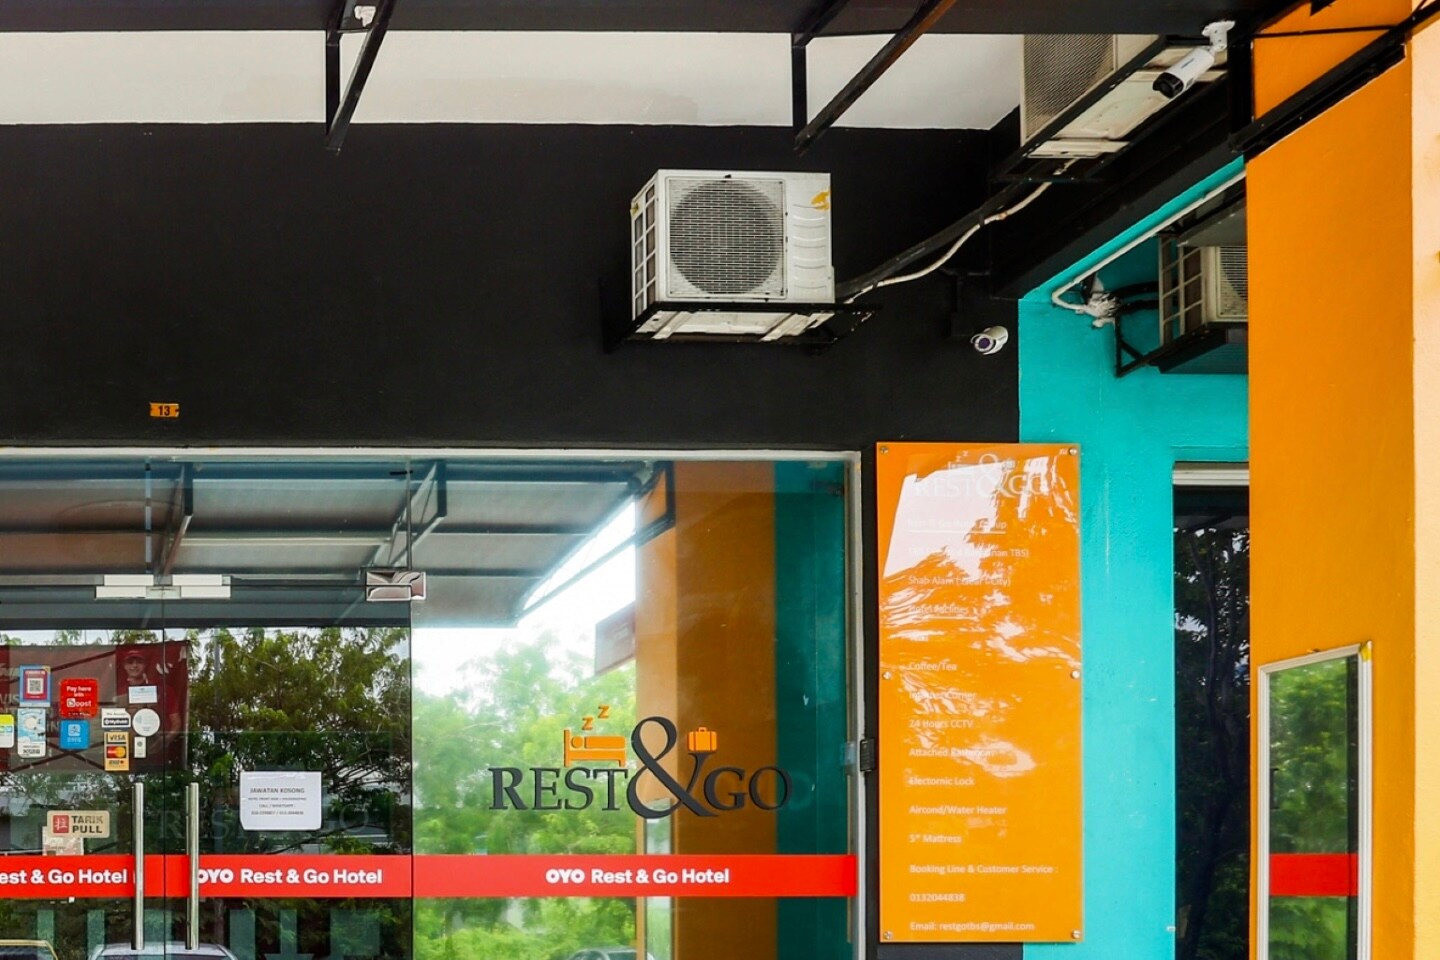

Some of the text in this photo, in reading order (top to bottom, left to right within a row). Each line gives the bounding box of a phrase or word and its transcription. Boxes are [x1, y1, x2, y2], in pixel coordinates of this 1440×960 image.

[159, 405, 170, 416] 13
[950, 720, 974, 729] CCTV
[954, 776, 975, 786] Lock
[976, 806, 1007, 815] Heater
[72, 815, 103, 824] TARIK
[73, 825, 103, 834] PULL
[909, 864, 946, 875] Booking
[947, 864, 966, 874] Line
[976, 865, 1020, 874] Customer
[1021, 864, 1054, 874] Service
[31, 870, 44, 884] &
[48, 870, 74, 884] Go
[78, 869, 127, 884] Hotel
[241, 869, 282, 884] Rest
[286, 869, 300, 884] &
[303, 869, 329, 884] Go
[333, 868, 383, 884] Hotel
[545, 868, 730, 884] OYO Rest & Go Hotel
